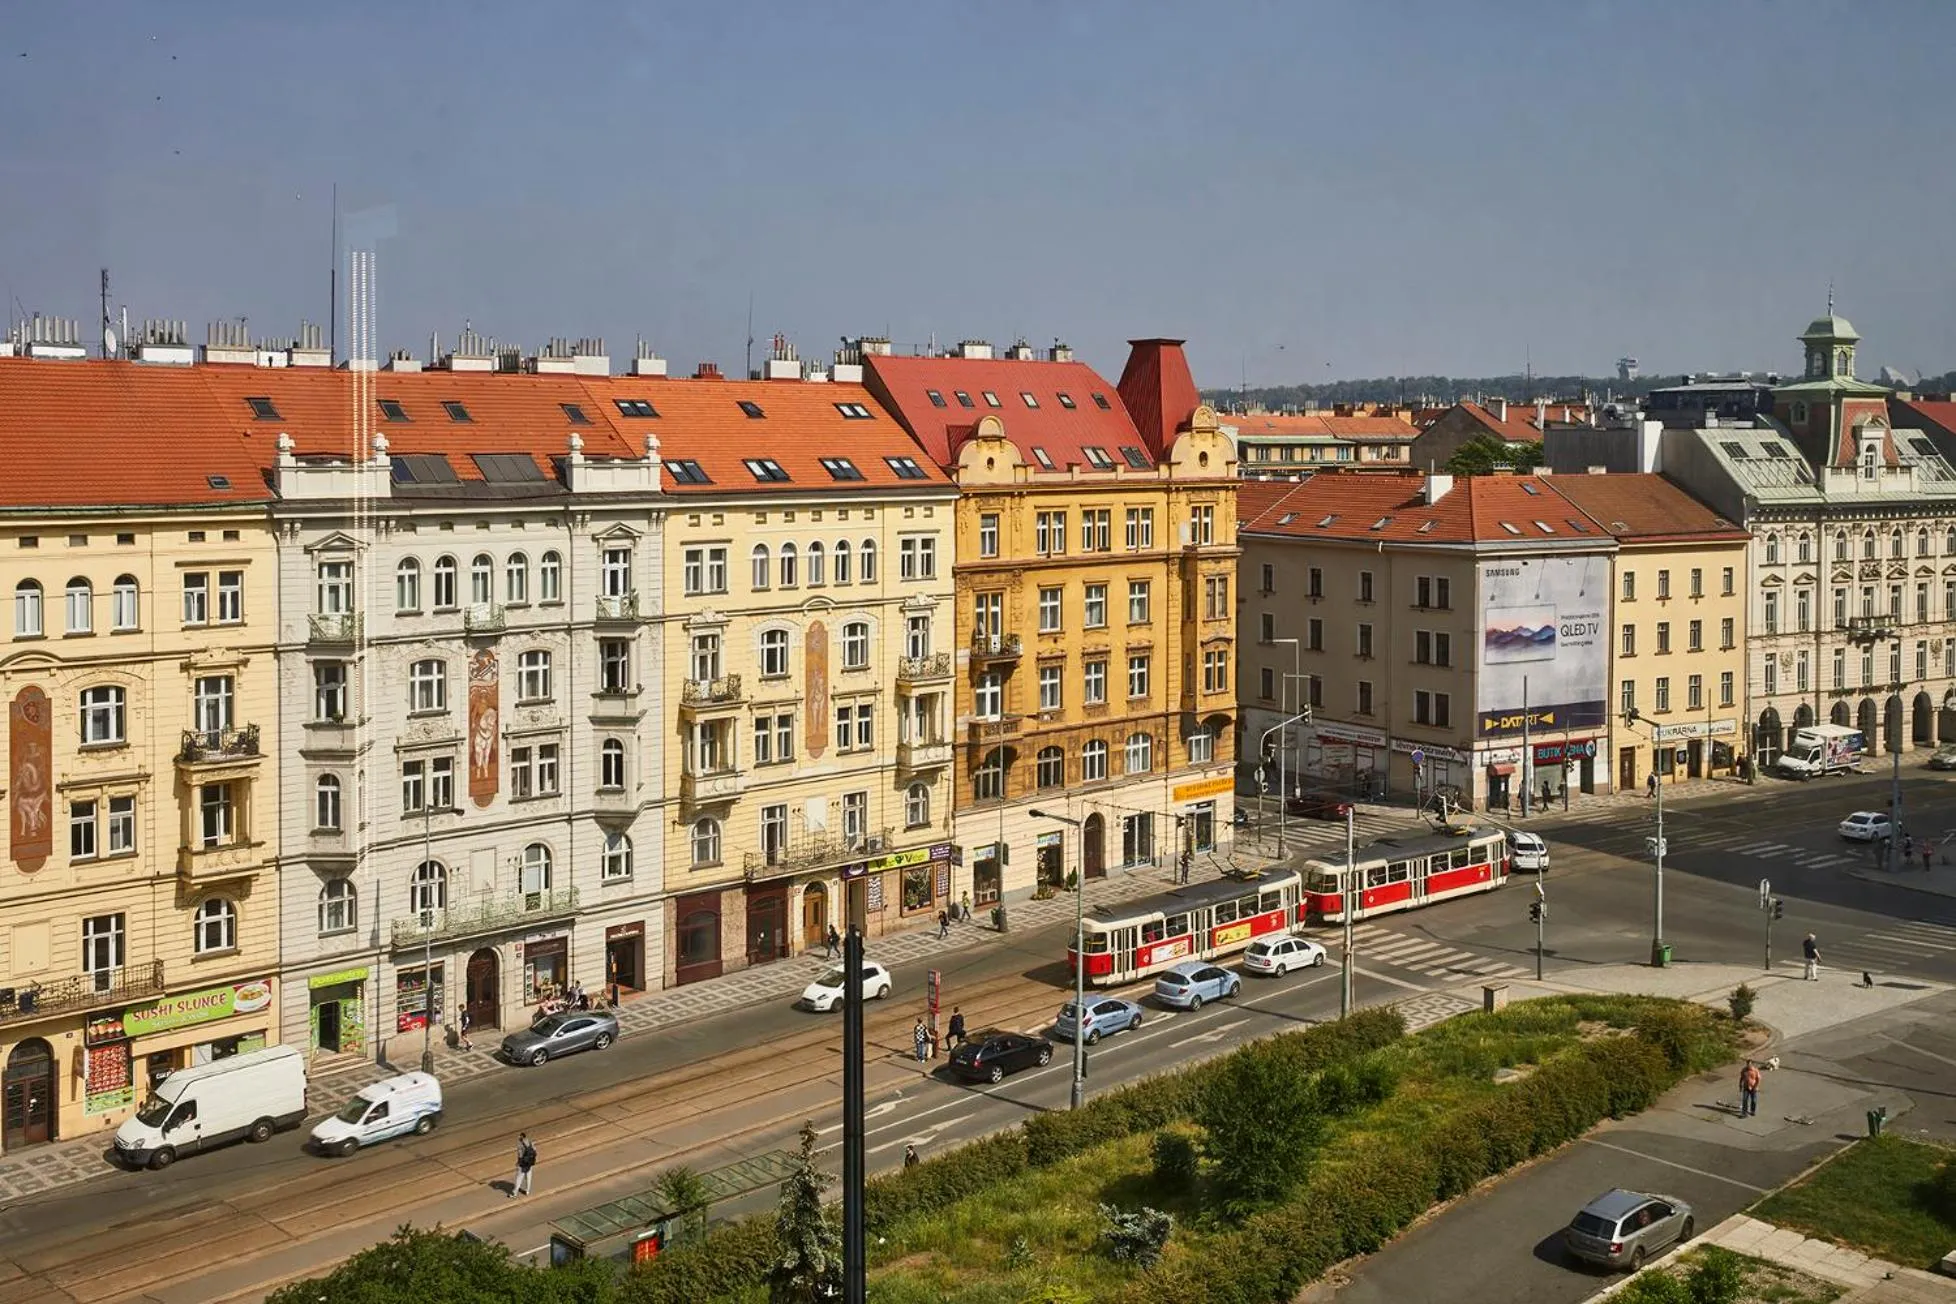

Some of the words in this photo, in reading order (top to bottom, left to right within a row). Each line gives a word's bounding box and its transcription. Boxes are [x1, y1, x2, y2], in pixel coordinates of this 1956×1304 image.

[1485, 568, 1520, 577] SAMSUNG
[1560, 623, 1586, 637] QLED
[1588, 622, 1599, 635] TV
[133, 1004, 172, 1022] SUSHI
[177, 993, 227, 1013] SLUNCE
